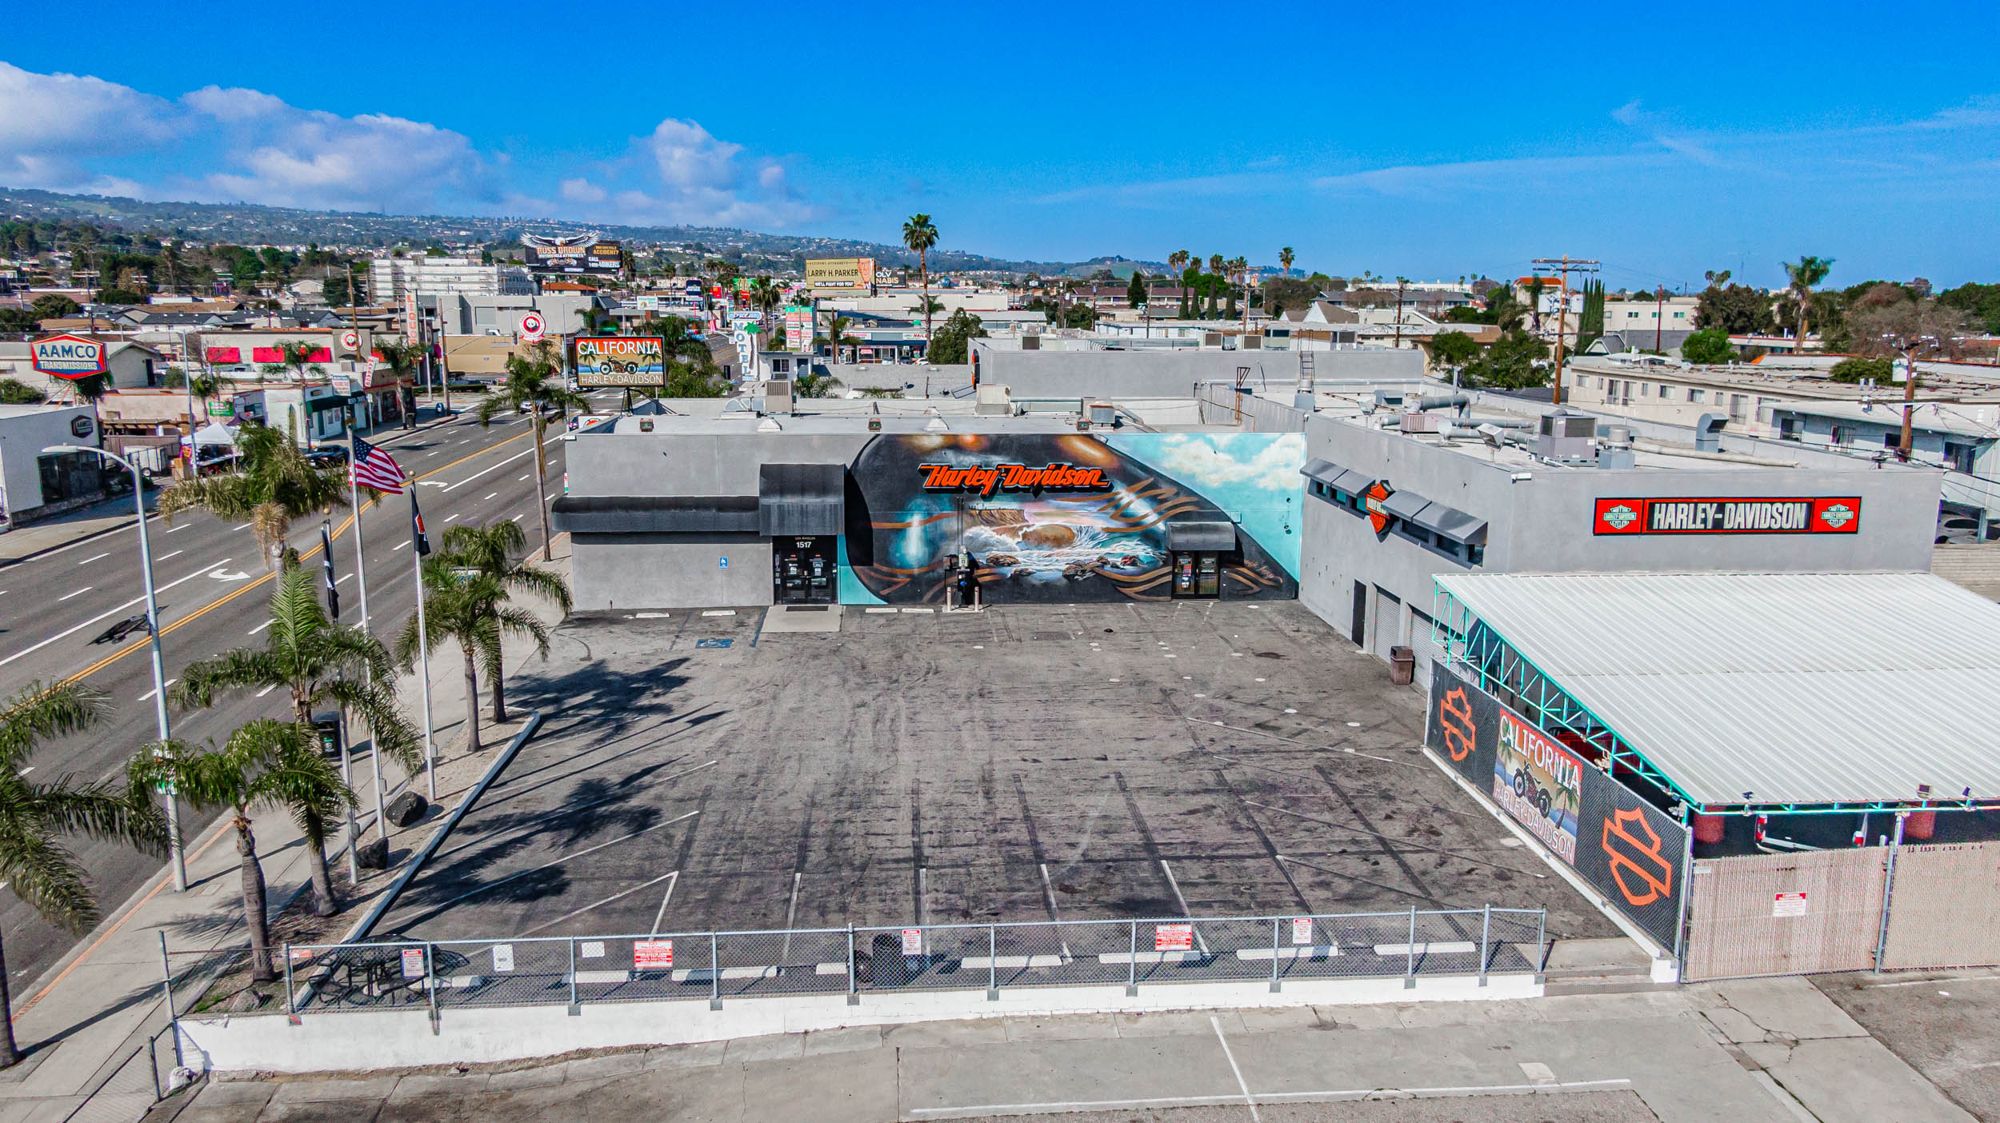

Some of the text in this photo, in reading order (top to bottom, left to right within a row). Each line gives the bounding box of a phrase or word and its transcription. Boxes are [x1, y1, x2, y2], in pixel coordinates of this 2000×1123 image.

[807, 269, 826, 277] LARRY
[835, 268, 859, 276] PARKER
[39, 344, 97, 359] AAMCO
[577, 341, 661, 355] CALIFORNIA
[734, 321, 751, 375] MOTEL
[581, 374, 662, 385] HARLEY-DAVIDSON
[919, 463, 1110, 496] Harley-Davidson
[1652, 502, 1808, 530] HARLEY-DAVIDSON
[796, 541, 812, 549] 1517
[1500, 715, 1581, 797] CALIFORNIA
[1493, 782, 1575, 863] HARLEY-DAVIDSON
